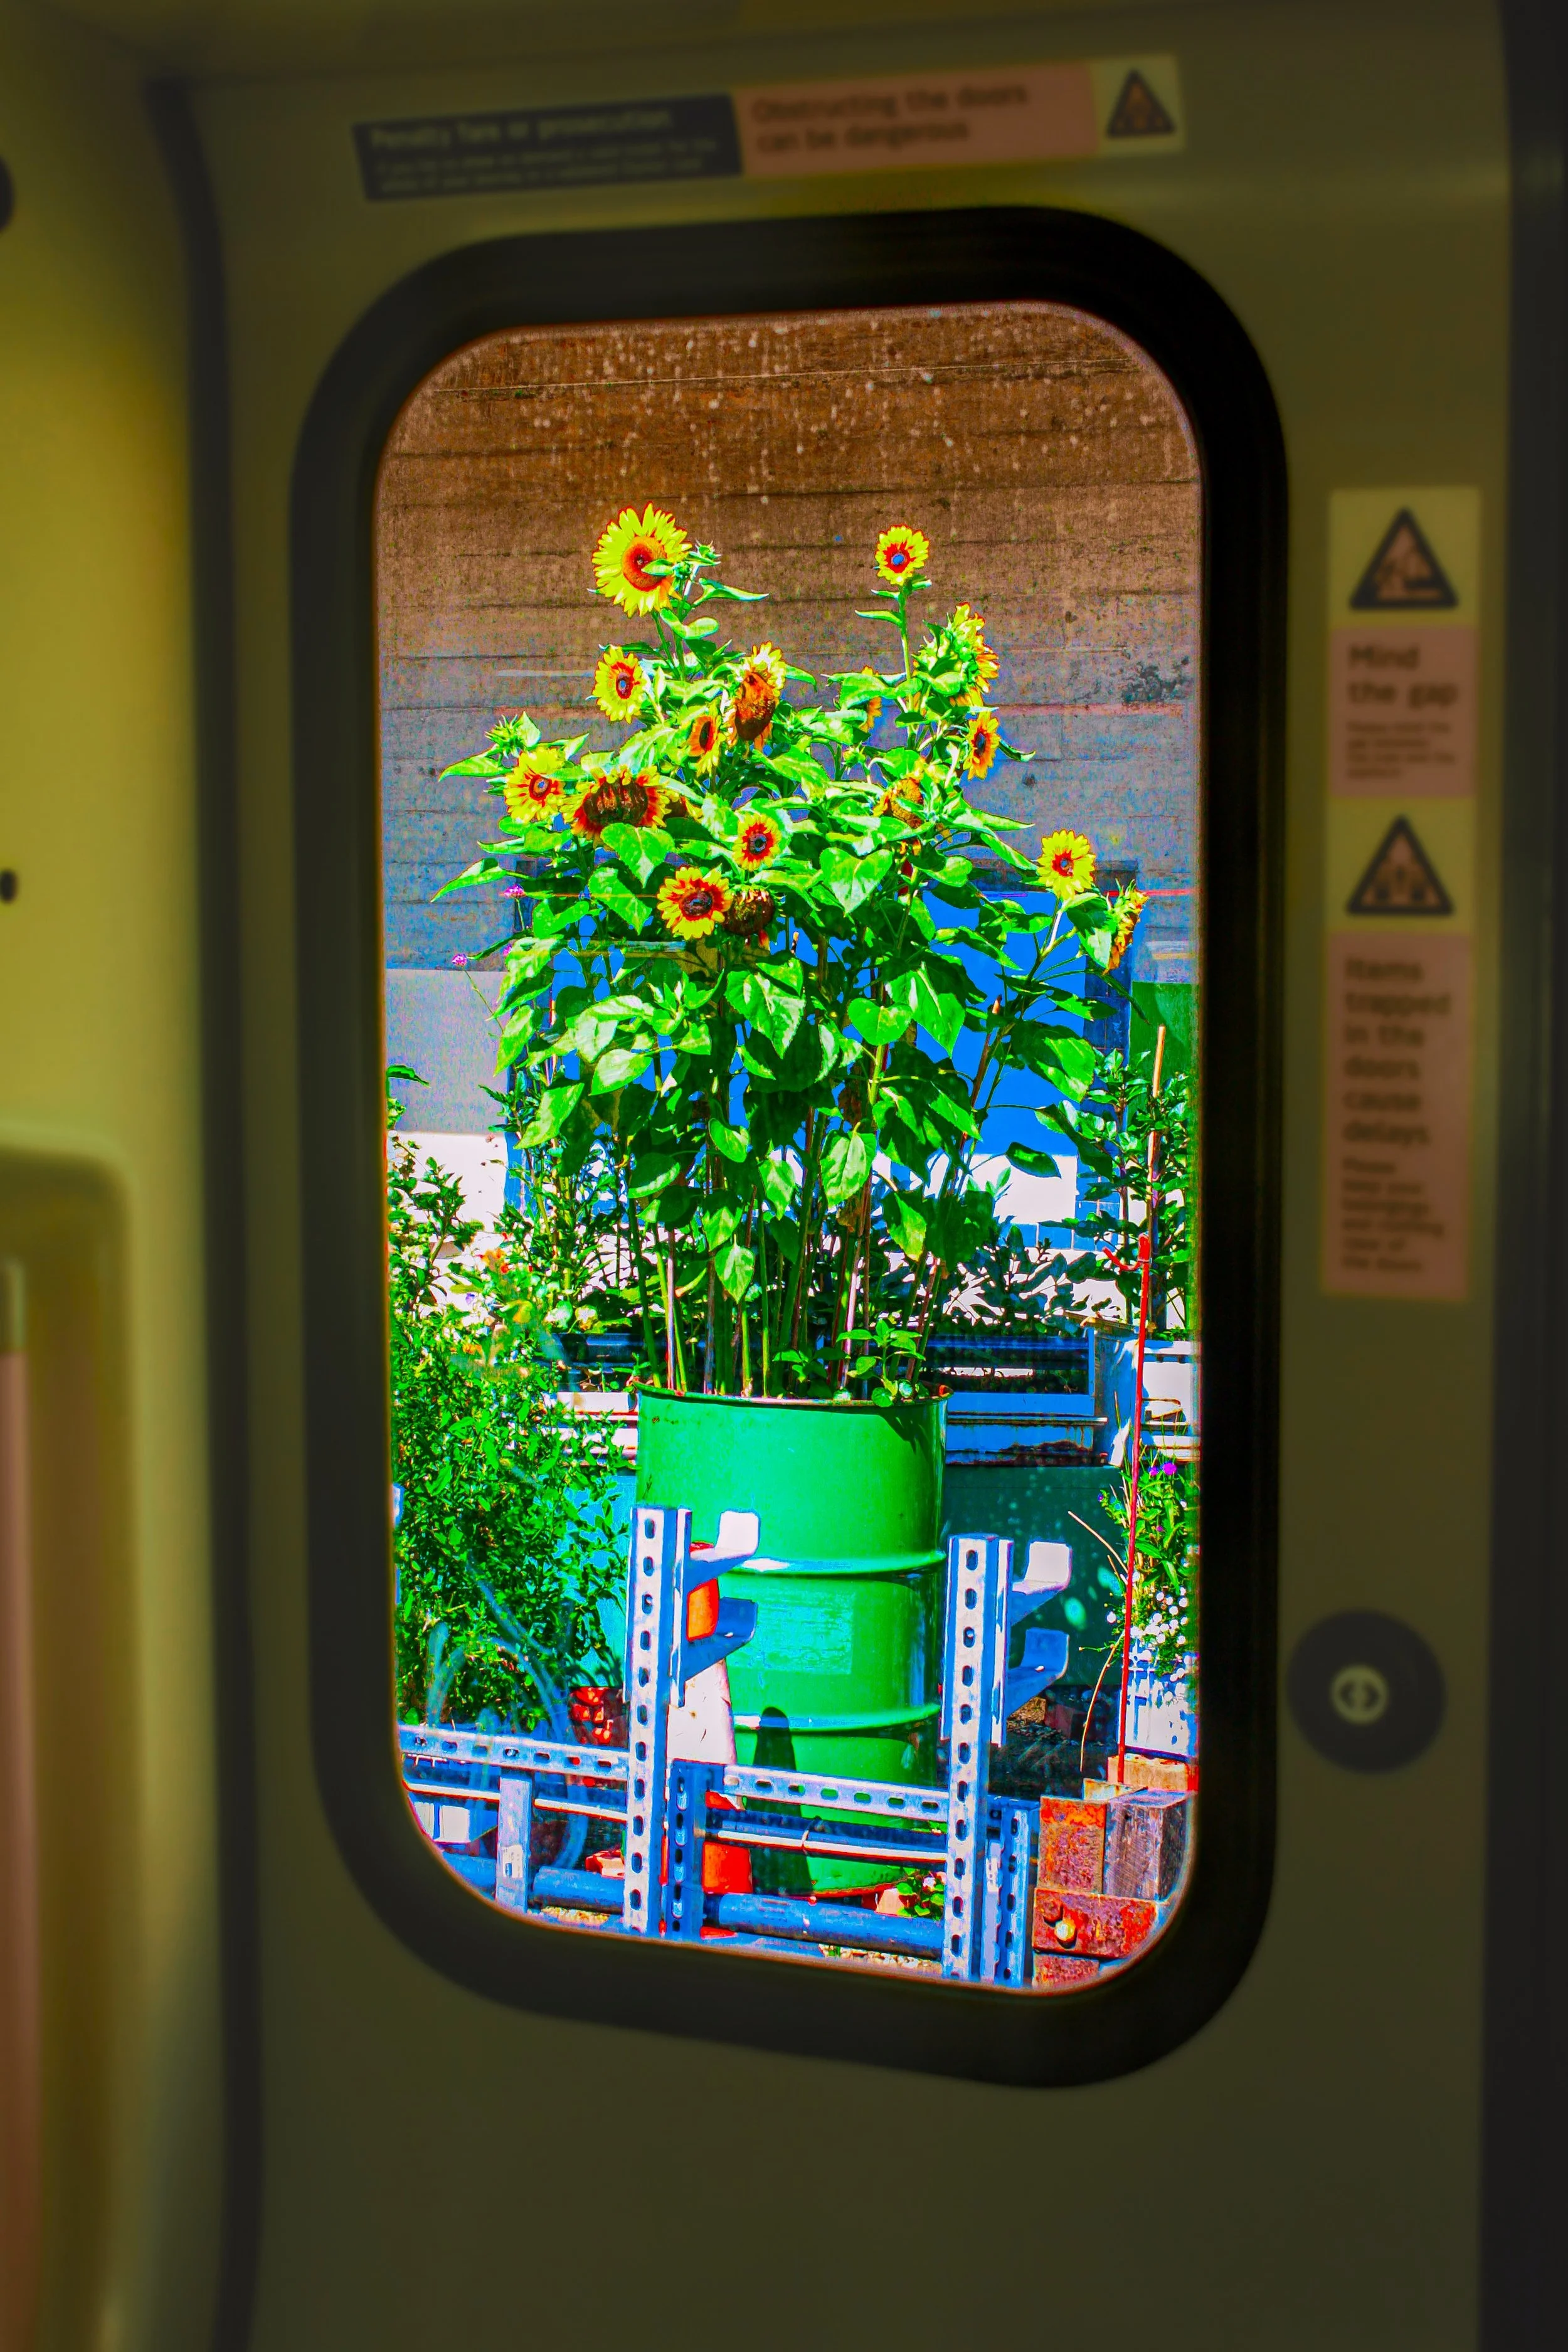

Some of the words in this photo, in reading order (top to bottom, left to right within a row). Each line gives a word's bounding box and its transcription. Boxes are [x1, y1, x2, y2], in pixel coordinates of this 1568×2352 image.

[753, 95, 898, 123] Obstructing
[906, 89, 947, 111] the
[958, 85, 1027, 107] doors
[757, 134, 798, 152] can
[807, 129, 835, 149] be
[845, 122, 968, 149] dangerous
[1348, 644, 1420, 670] Mind
[1348, 682, 1396, 704] the
[1408, 683, 1458, 711] gap
[1345, 958, 1424, 982] Items
[1345, 992, 1451, 1017] trapped
[1345, 1024, 1369, 1044] in
[1378, 1025, 1424, 1047] the
[1343, 1056, 1419, 1079] doors
[1342, 1091, 1422, 1112] cause
[1342, 1120, 1430, 1149] delays
